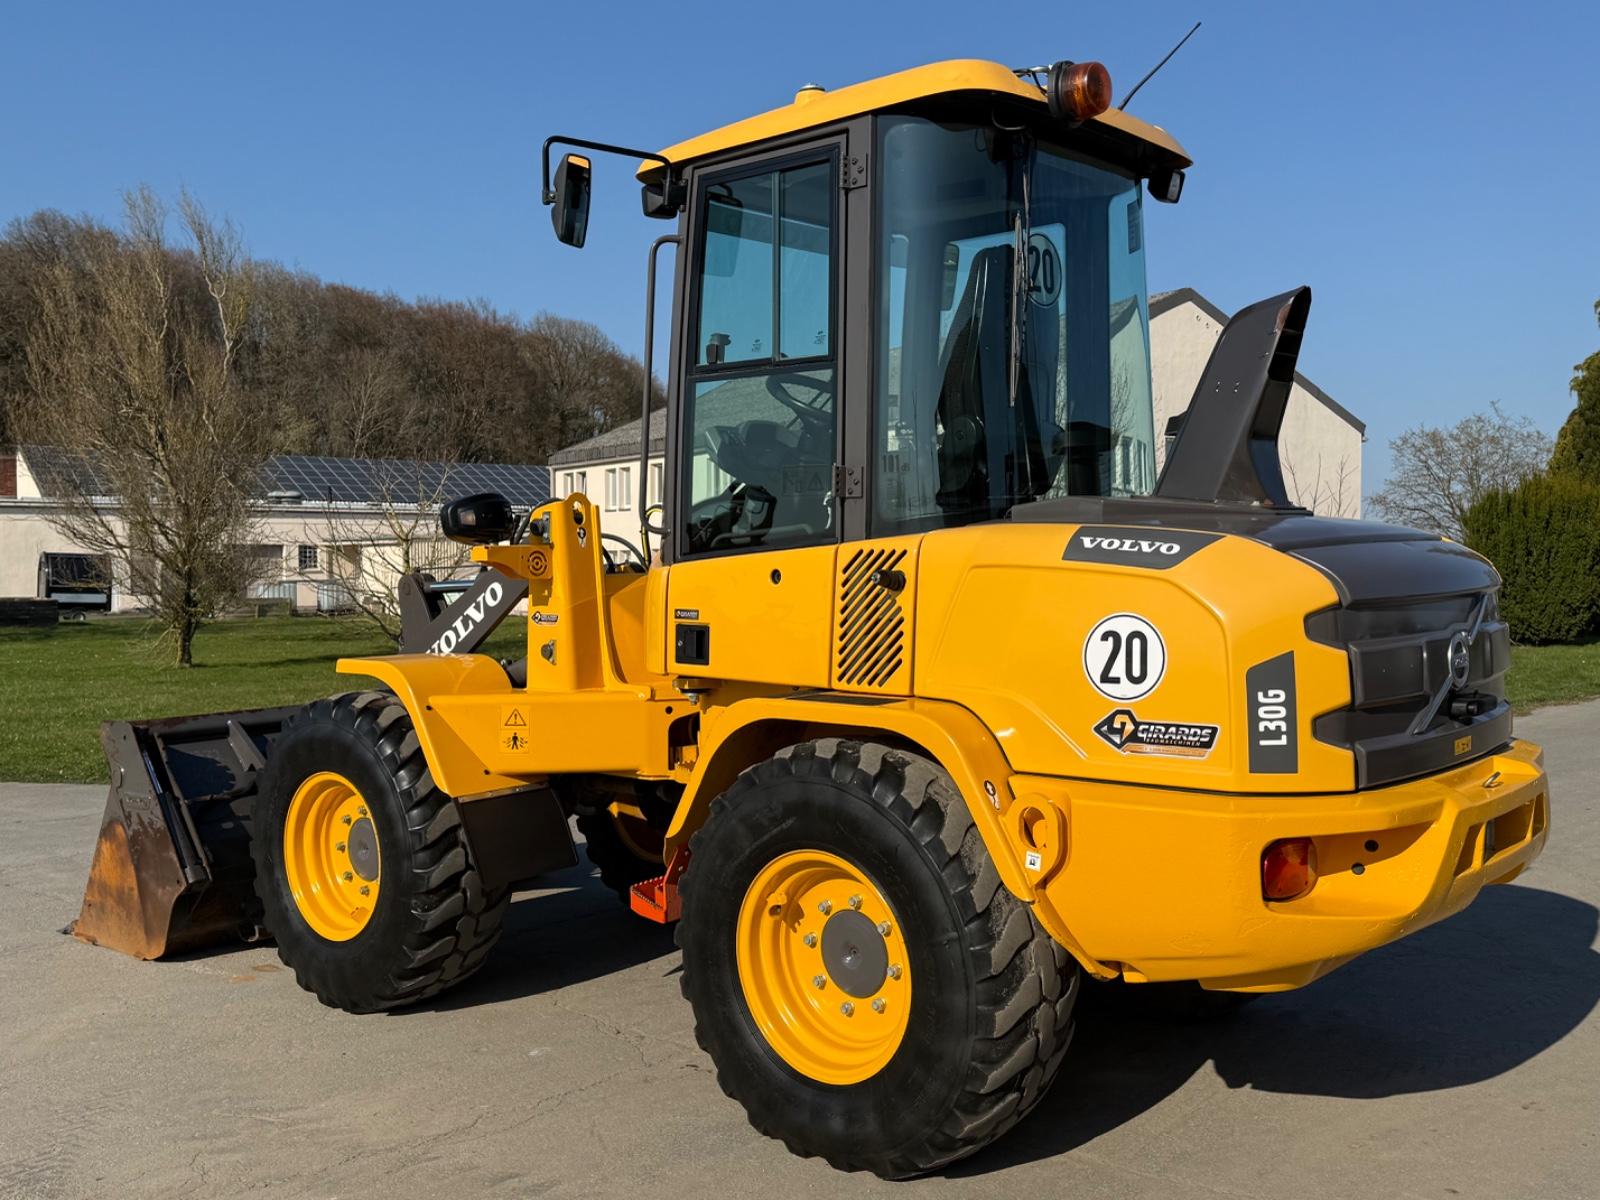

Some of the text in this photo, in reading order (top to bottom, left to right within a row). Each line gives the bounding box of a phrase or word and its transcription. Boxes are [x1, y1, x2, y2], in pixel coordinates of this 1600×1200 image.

[1027, 246, 1054, 294] 20
[1080, 536, 1181, 555] VOLVO
[1100, 630, 1148, 685] 20
[1137, 724, 1212, 742] GIRARDS
[1257, 689, 1287, 746] L30G
